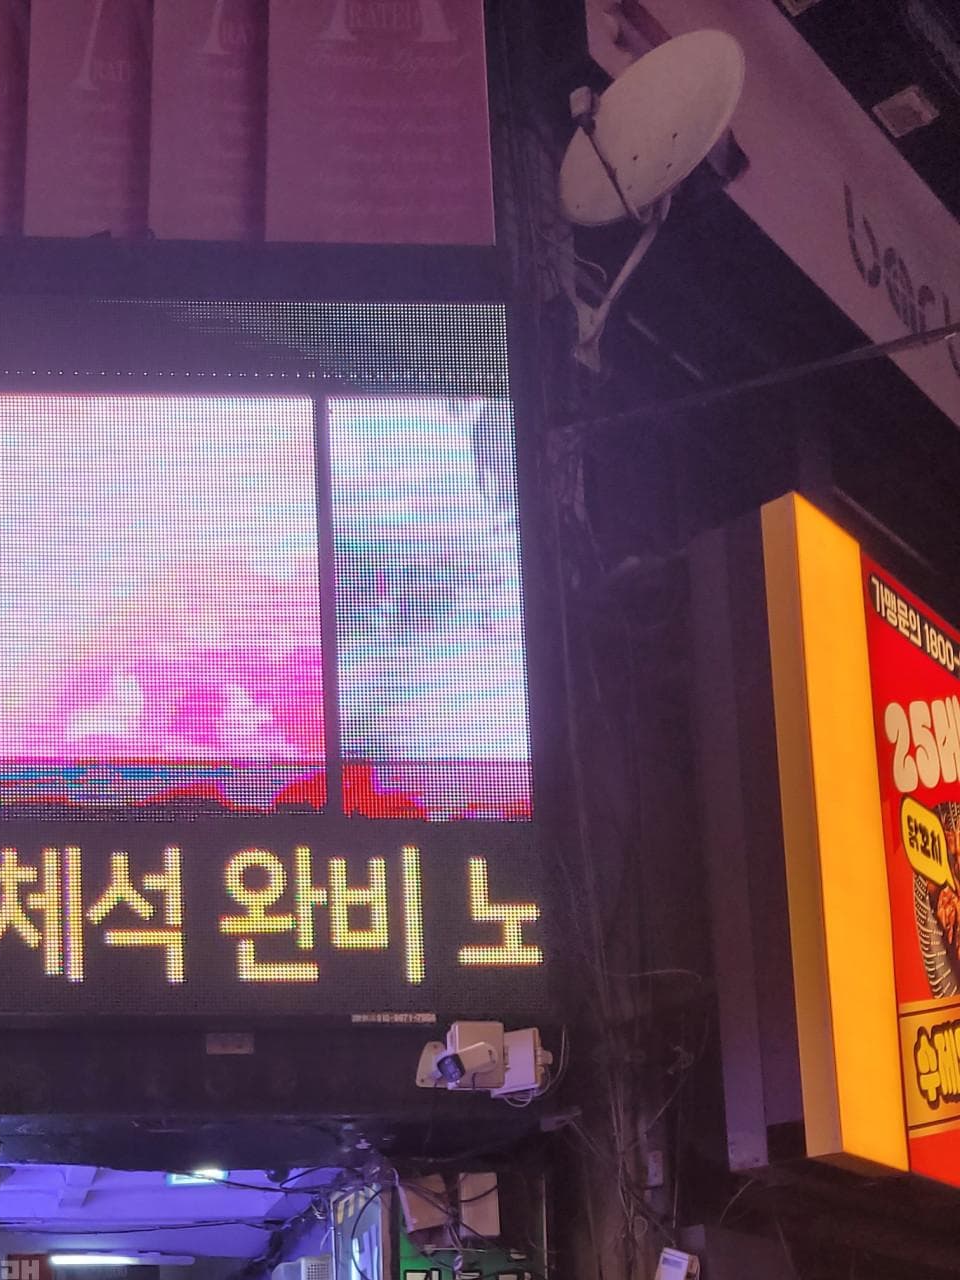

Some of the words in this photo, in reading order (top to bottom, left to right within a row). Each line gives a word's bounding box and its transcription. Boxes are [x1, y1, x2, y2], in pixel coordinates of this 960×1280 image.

[871, 575, 921, 647] 가맹문의
[220, 845, 426, 985] 완비
[458, 855, 544, 966] 노
[916, 1027, 960, 1103] 수제
